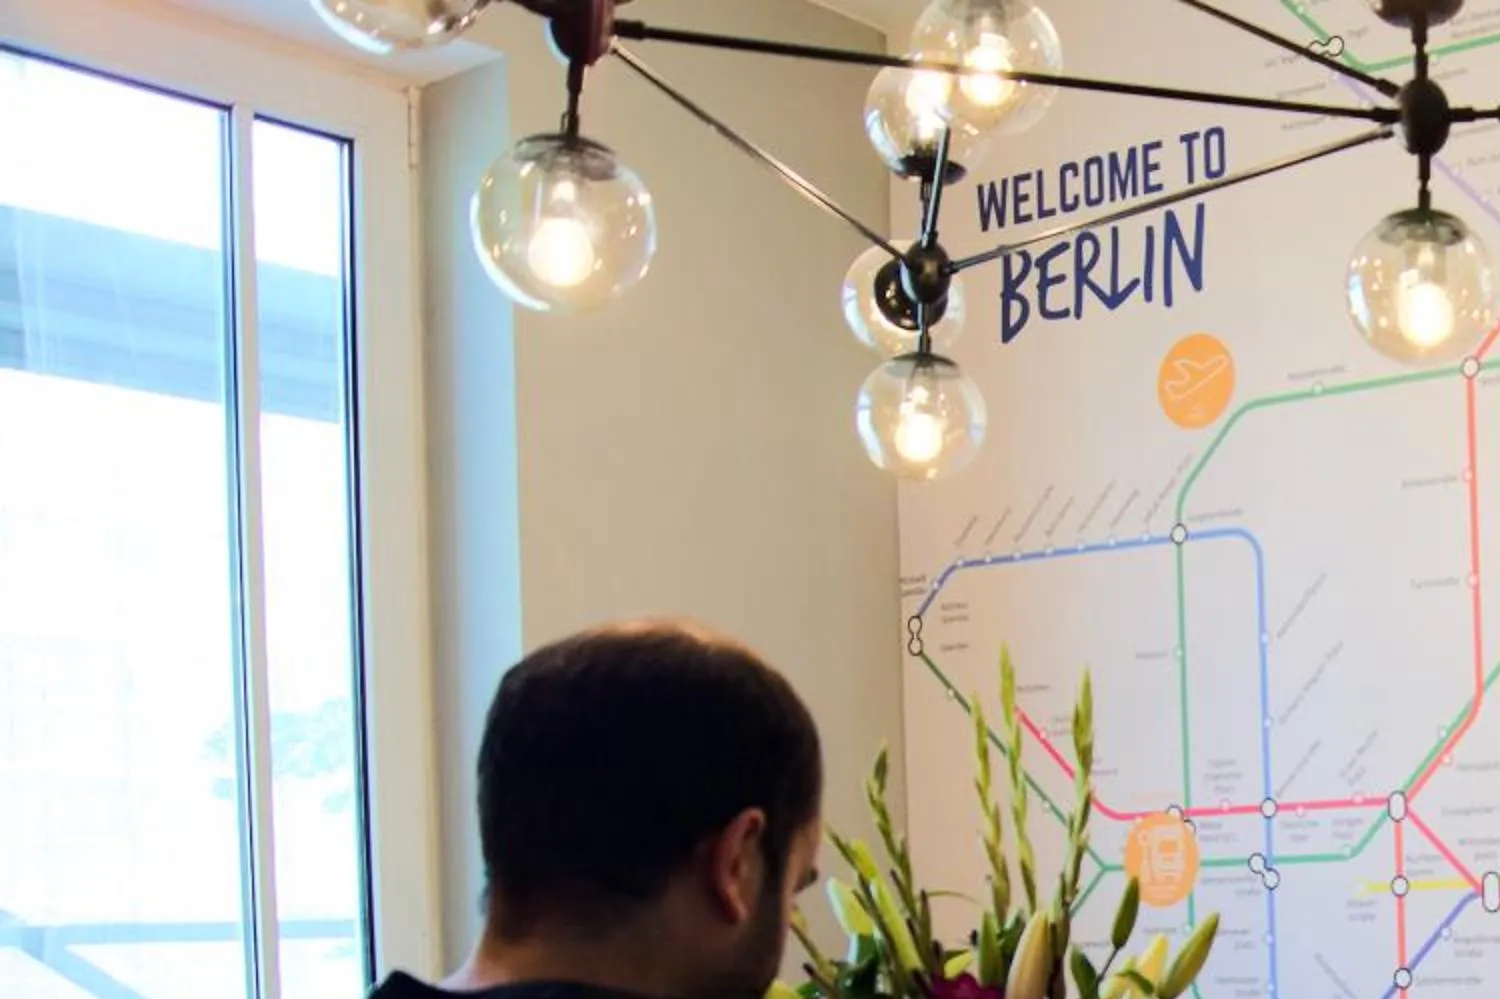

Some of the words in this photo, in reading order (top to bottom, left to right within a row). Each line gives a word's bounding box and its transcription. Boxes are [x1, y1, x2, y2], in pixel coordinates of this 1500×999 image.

[977, 140, 1163, 232] WELCOME
[1180, 127, 1226, 183] TO
[1001, 203, 1205, 344] BERLIN
